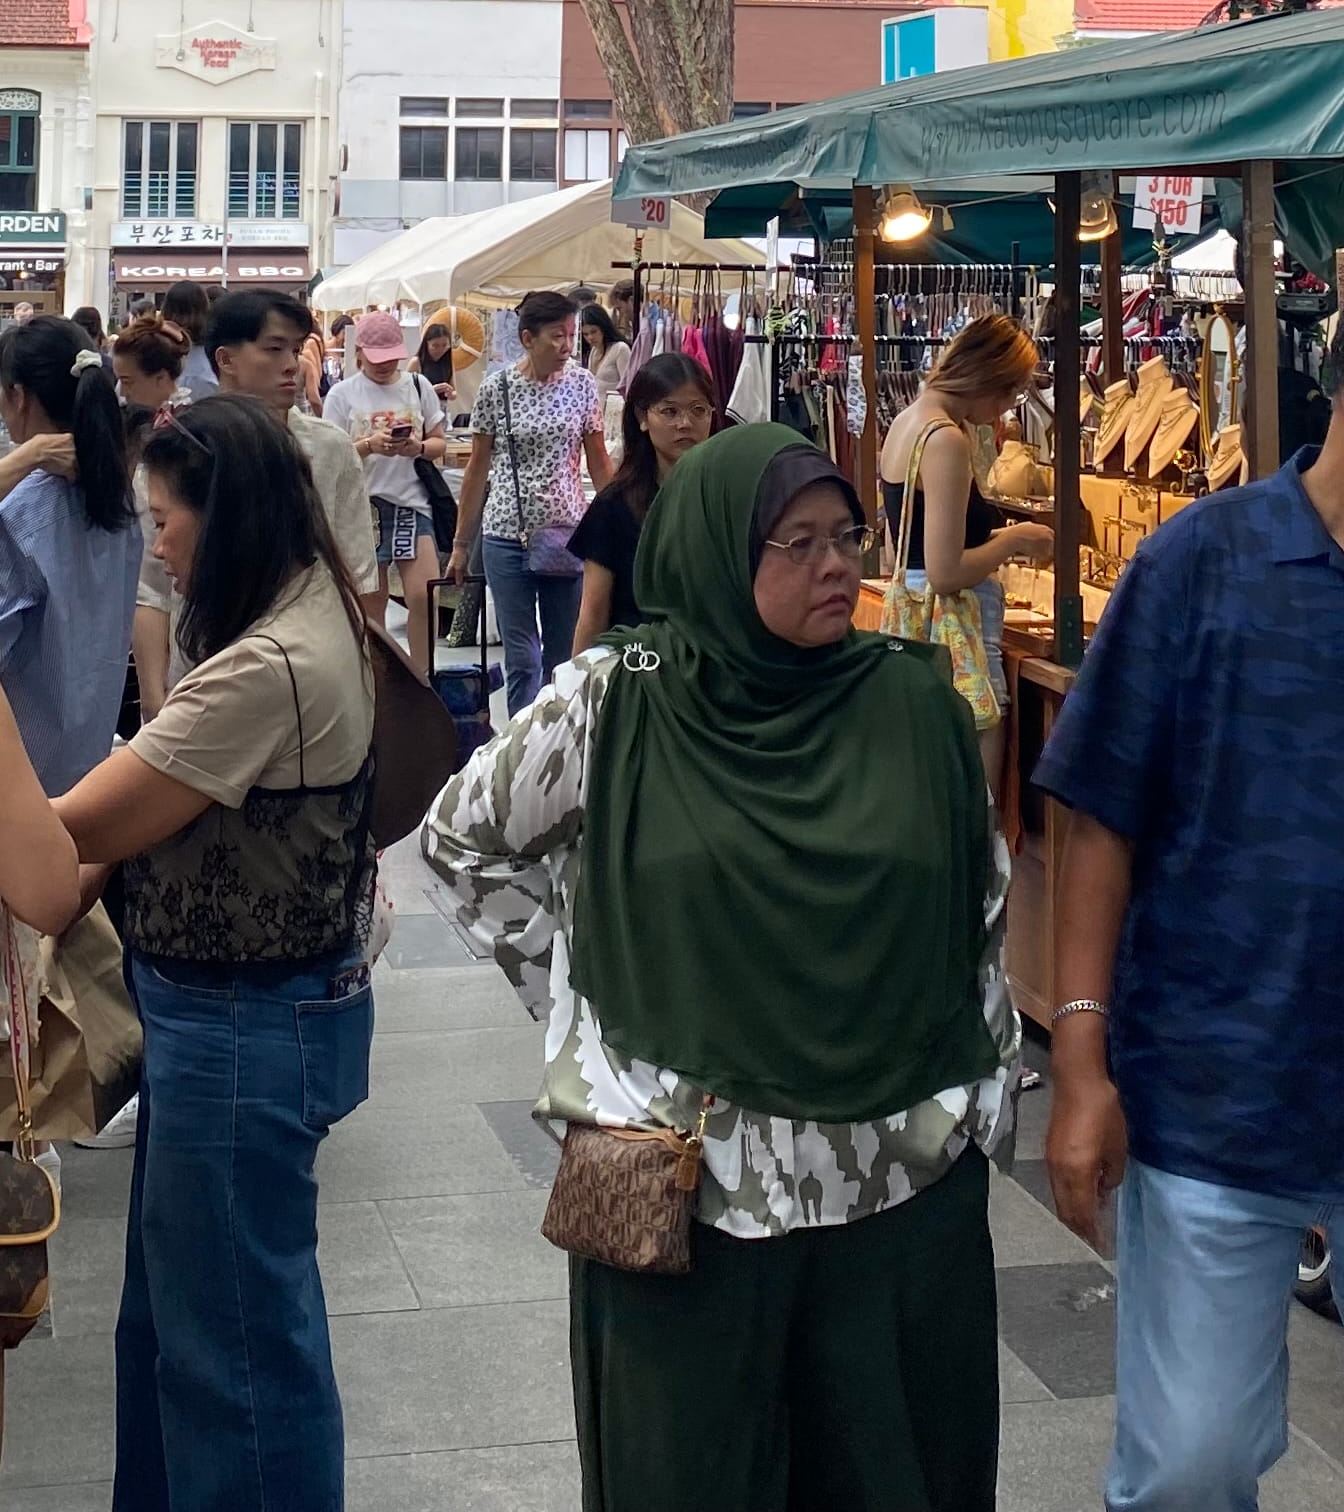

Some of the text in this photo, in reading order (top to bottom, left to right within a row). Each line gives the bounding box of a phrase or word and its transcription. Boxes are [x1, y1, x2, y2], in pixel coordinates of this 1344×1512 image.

[191, 38, 243, 49] Authentic
[200, 48, 237, 59] Korean
[203, 57, 230, 68] Food
[1148, 177, 1192, 196] 3 FOR
[641, 197, 666, 223] $20
[1150, 197, 1187, 226] $150
[129, 224, 225, 244] 부산포차
[35, 259, 59, 272] Bar
[121, 266, 304, 277] KOREA BBQ
